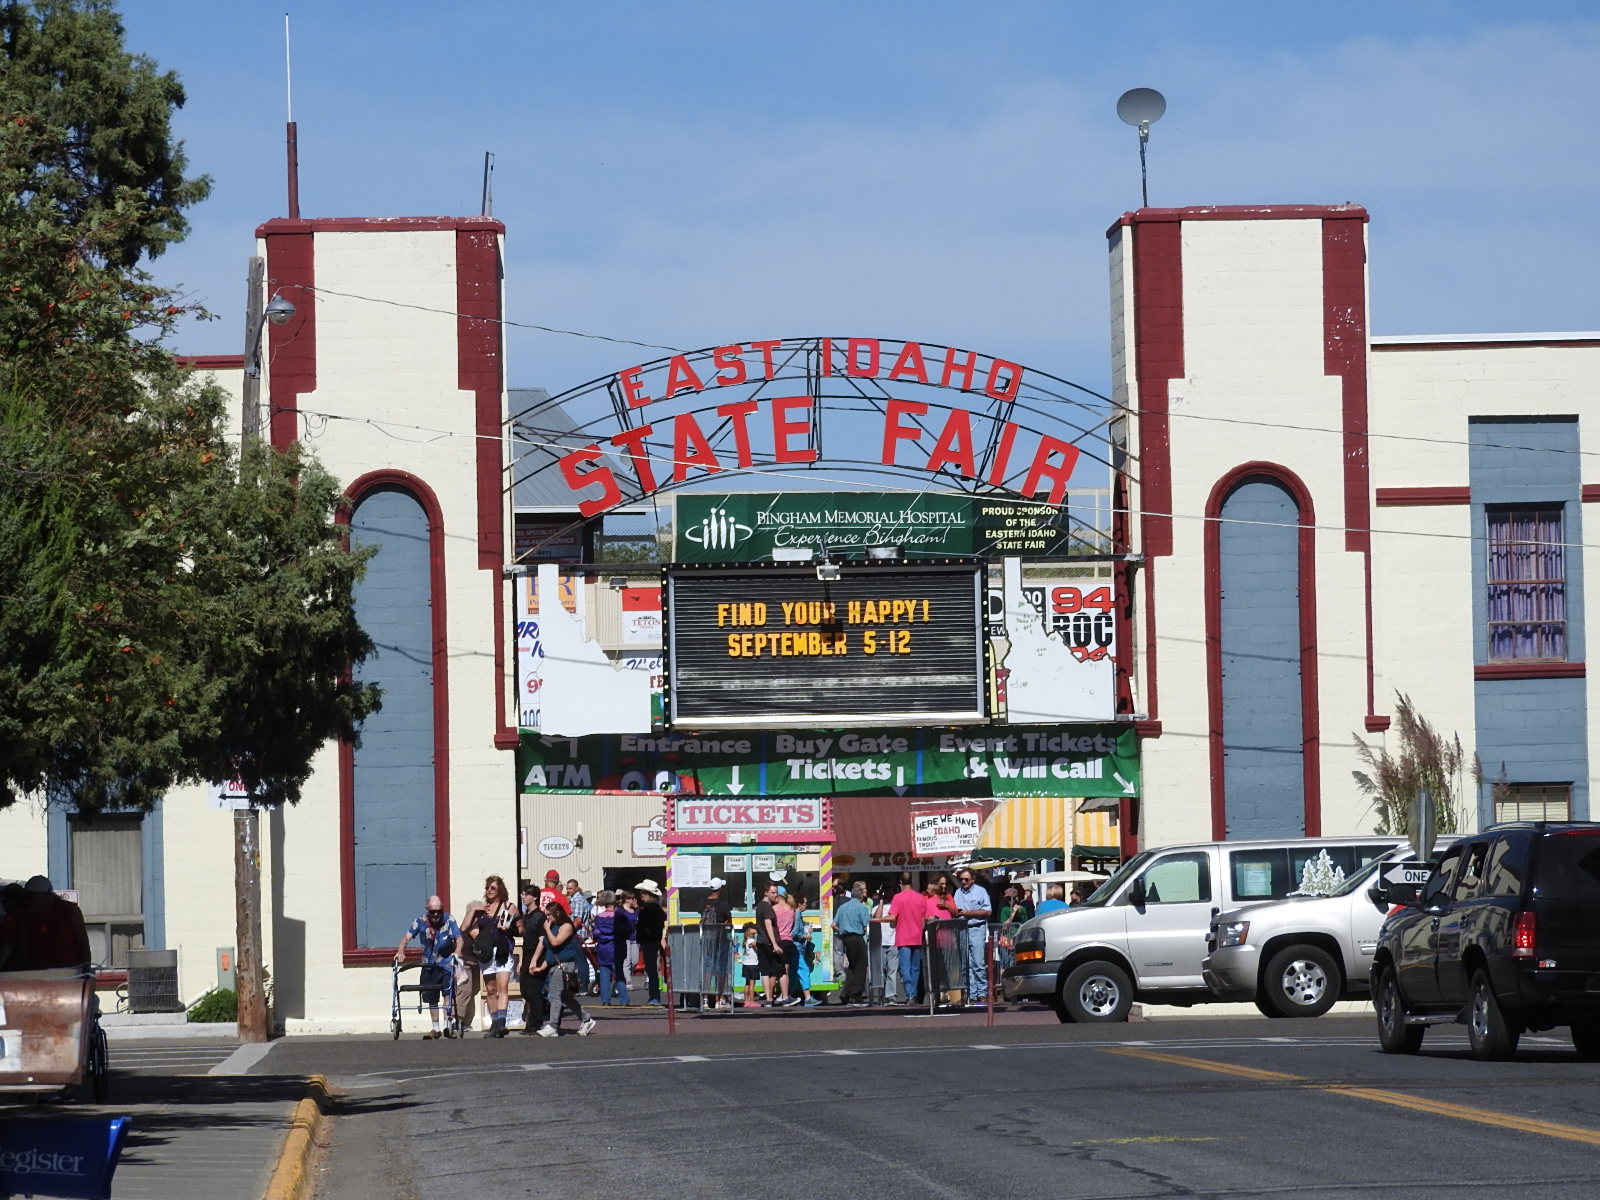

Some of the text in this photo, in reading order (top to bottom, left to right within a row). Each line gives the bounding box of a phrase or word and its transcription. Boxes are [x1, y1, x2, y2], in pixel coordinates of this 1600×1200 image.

[619, 337, 1024, 409] EAST IDAHO
[560, 396, 1081, 518] STATE FAIR
[757, 510, 965, 524] BINGHAM MEMORIAL HOSPITAL
[982, 507, 1014, 516] PROUD
[1005, 518, 1036, 527] OF THE
[774, 524, 950, 547] Experience Bingham!
[985, 529, 1056, 539] EASTERN IDAHO
[996, 540, 1045, 550] STATE FAIR
[1051, 587, 1115, 613] 94
[718, 600, 930, 627] FIND YOUR HAPPY!
[728, 630, 911, 657] SEPTEMBER 5-12
[620, 735, 751, 753] Entrance
[776, 734, 908, 758] Buy Gate
[939, 732, 1117, 752] Event Tickets
[524, 764, 592, 787] ATM
[787, 758, 891, 780] Tickets
[963, 757, 1102, 779] & Will Call
[683, 804, 814, 825] TICKETS
[916, 814, 977, 831] HERE WE HAVE
[934, 826, 960, 835] IDAHO
[543, 843, 570, 851] TICKETS
[1404, 871, 1427, 882] ONE
[0, 1148, 84, 1175] egister
